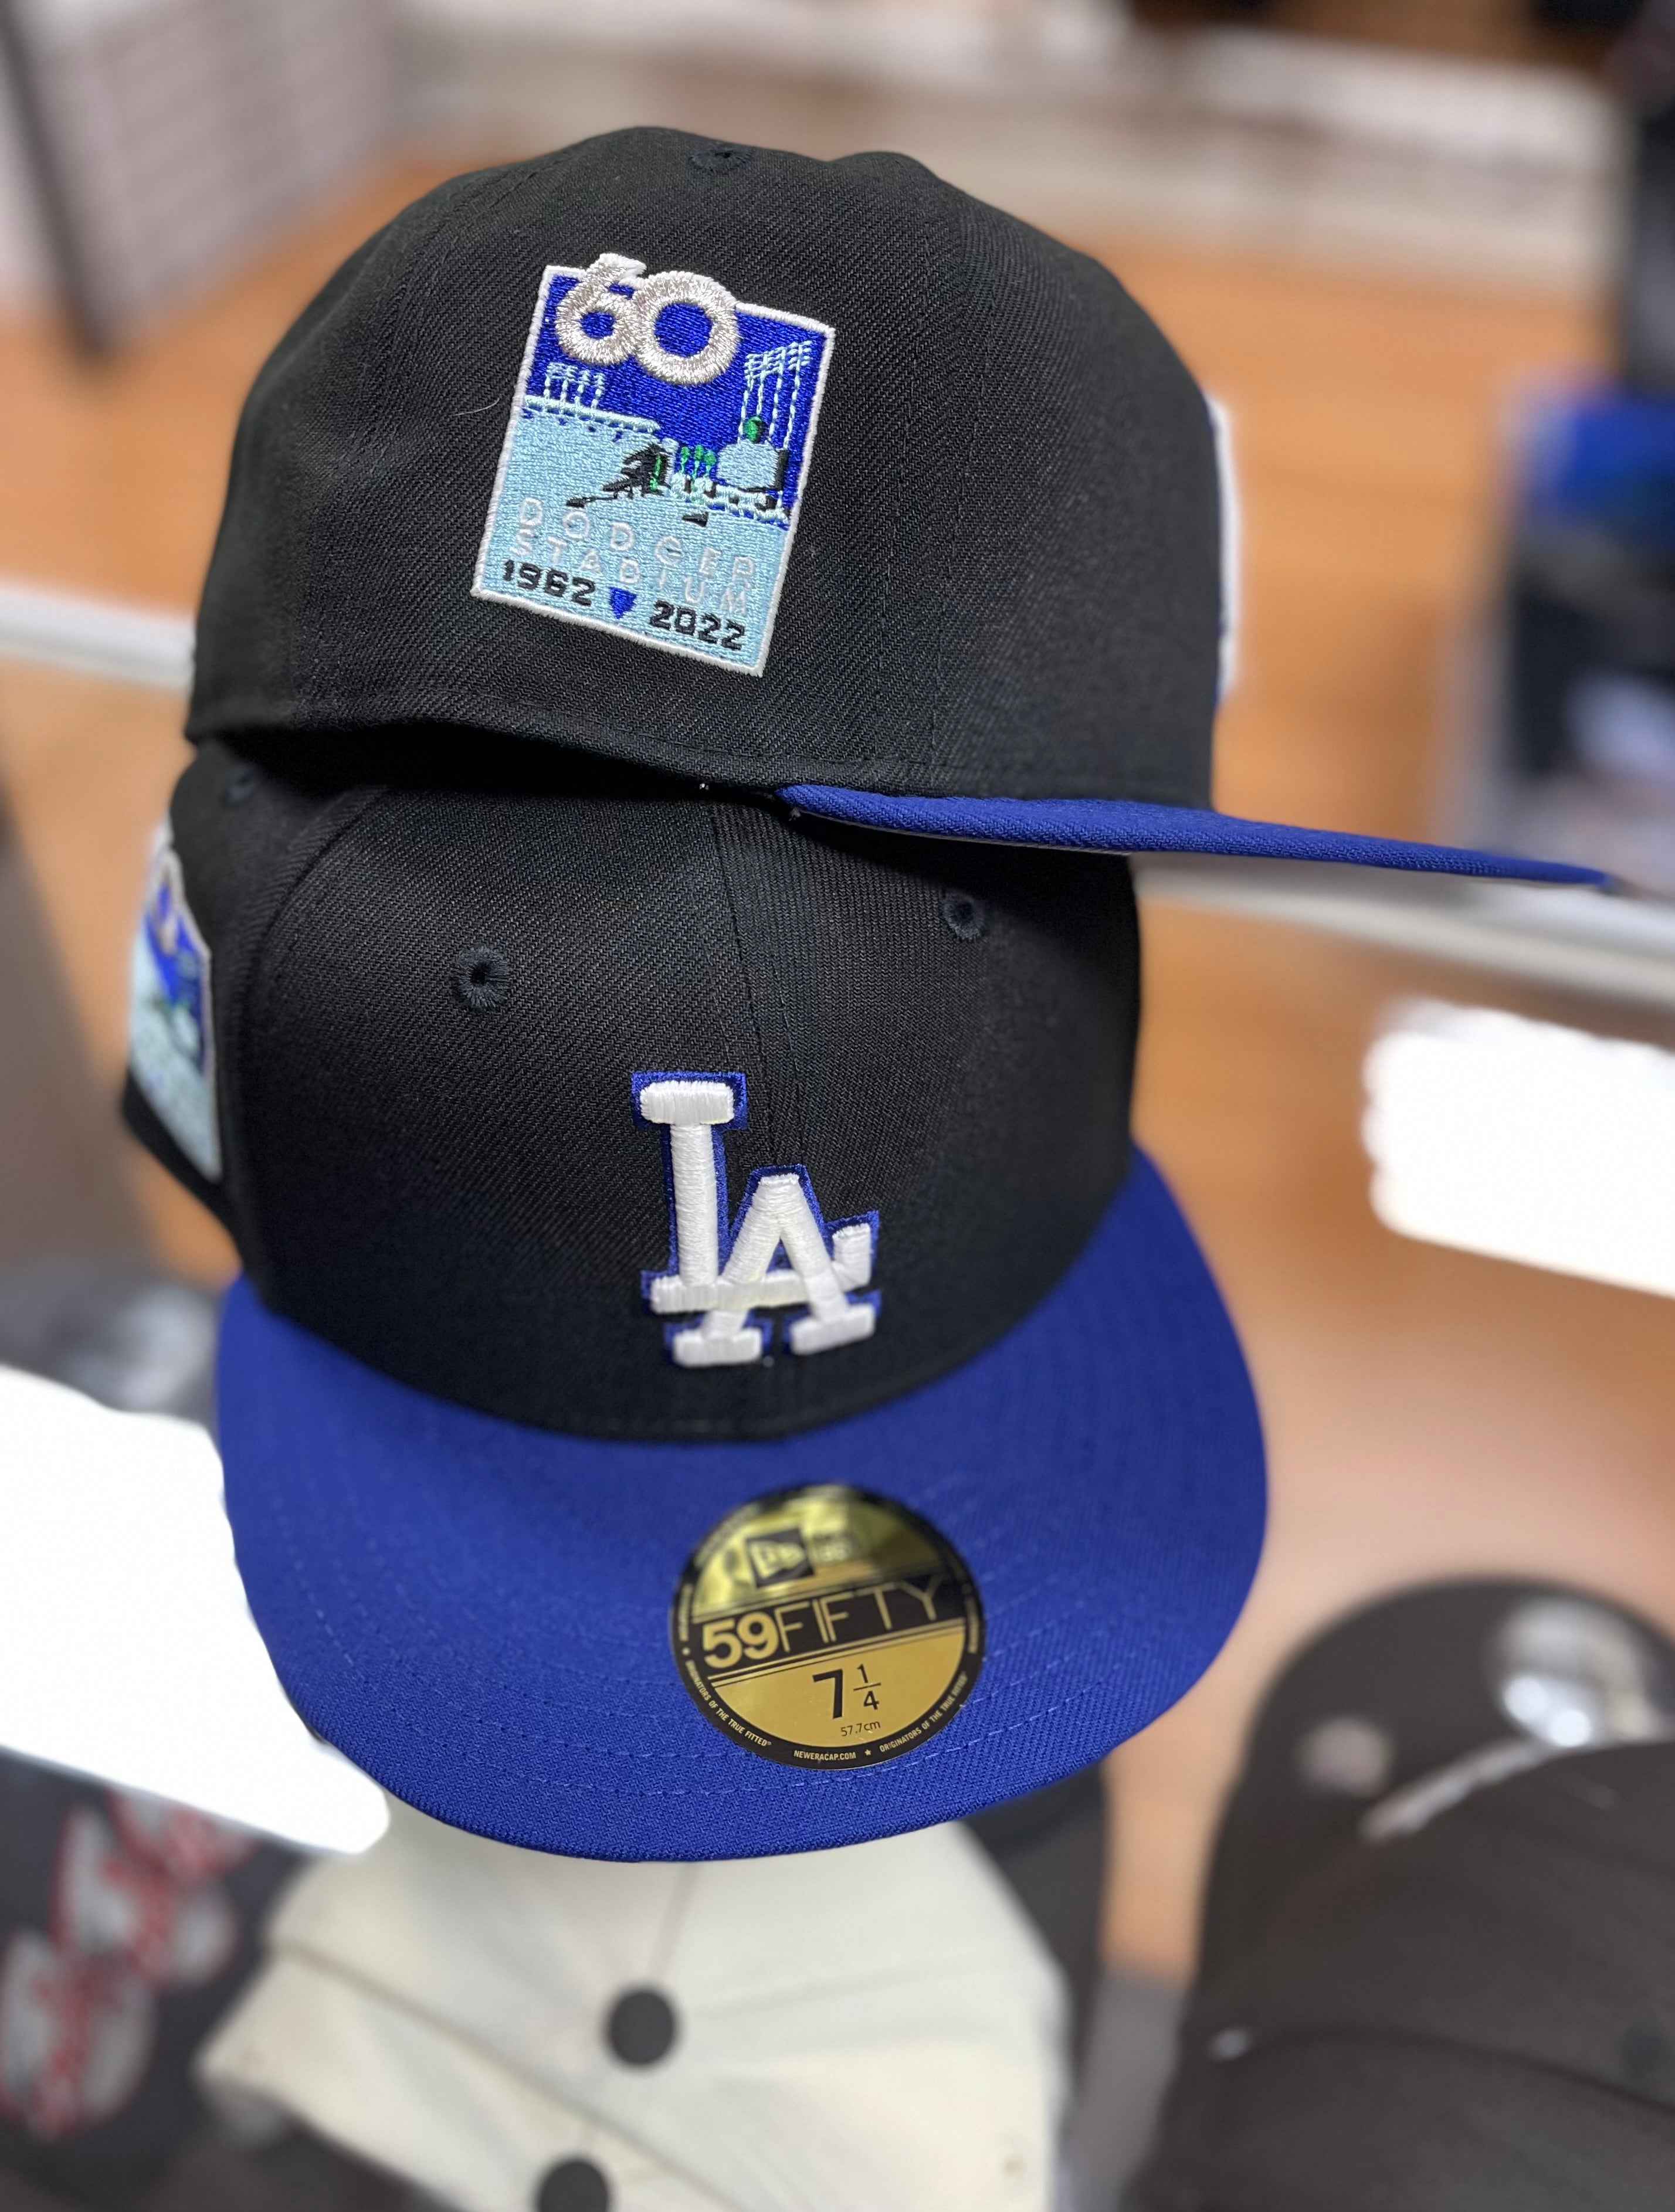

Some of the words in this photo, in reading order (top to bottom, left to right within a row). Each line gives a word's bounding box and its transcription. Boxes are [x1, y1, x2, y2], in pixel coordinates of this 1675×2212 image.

[556, 253, 739, 386] 60
[509, 528, 747, 616] STADIUM
[519, 497, 755, 590] DODGER
[501, 559, 596, 606] 1962
[649, 599, 746, 650] 2022
[632, 1071, 881, 1368] LA
[703, 1575, 943, 1669] 59FIFTY
[686, 1660, 711, 1701] GINATORS
[708, 1700, 718, 1709] OF
[716, 1708, 729, 1721] THE
[728, 1718, 745, 1734] TRUE
[812, 1668, 843, 1719] 7
[840, 1721, 881, 1736] 57.7cm
[879, 1727, 922, 1753] ORIGINATORS
[921, 1720, 931, 1730] OF
[928, 1709, 943, 1722] THE
[940, 1695, 955, 1711] TRUE
[794, 1749, 856, 1760] NEWERACAP.COM
